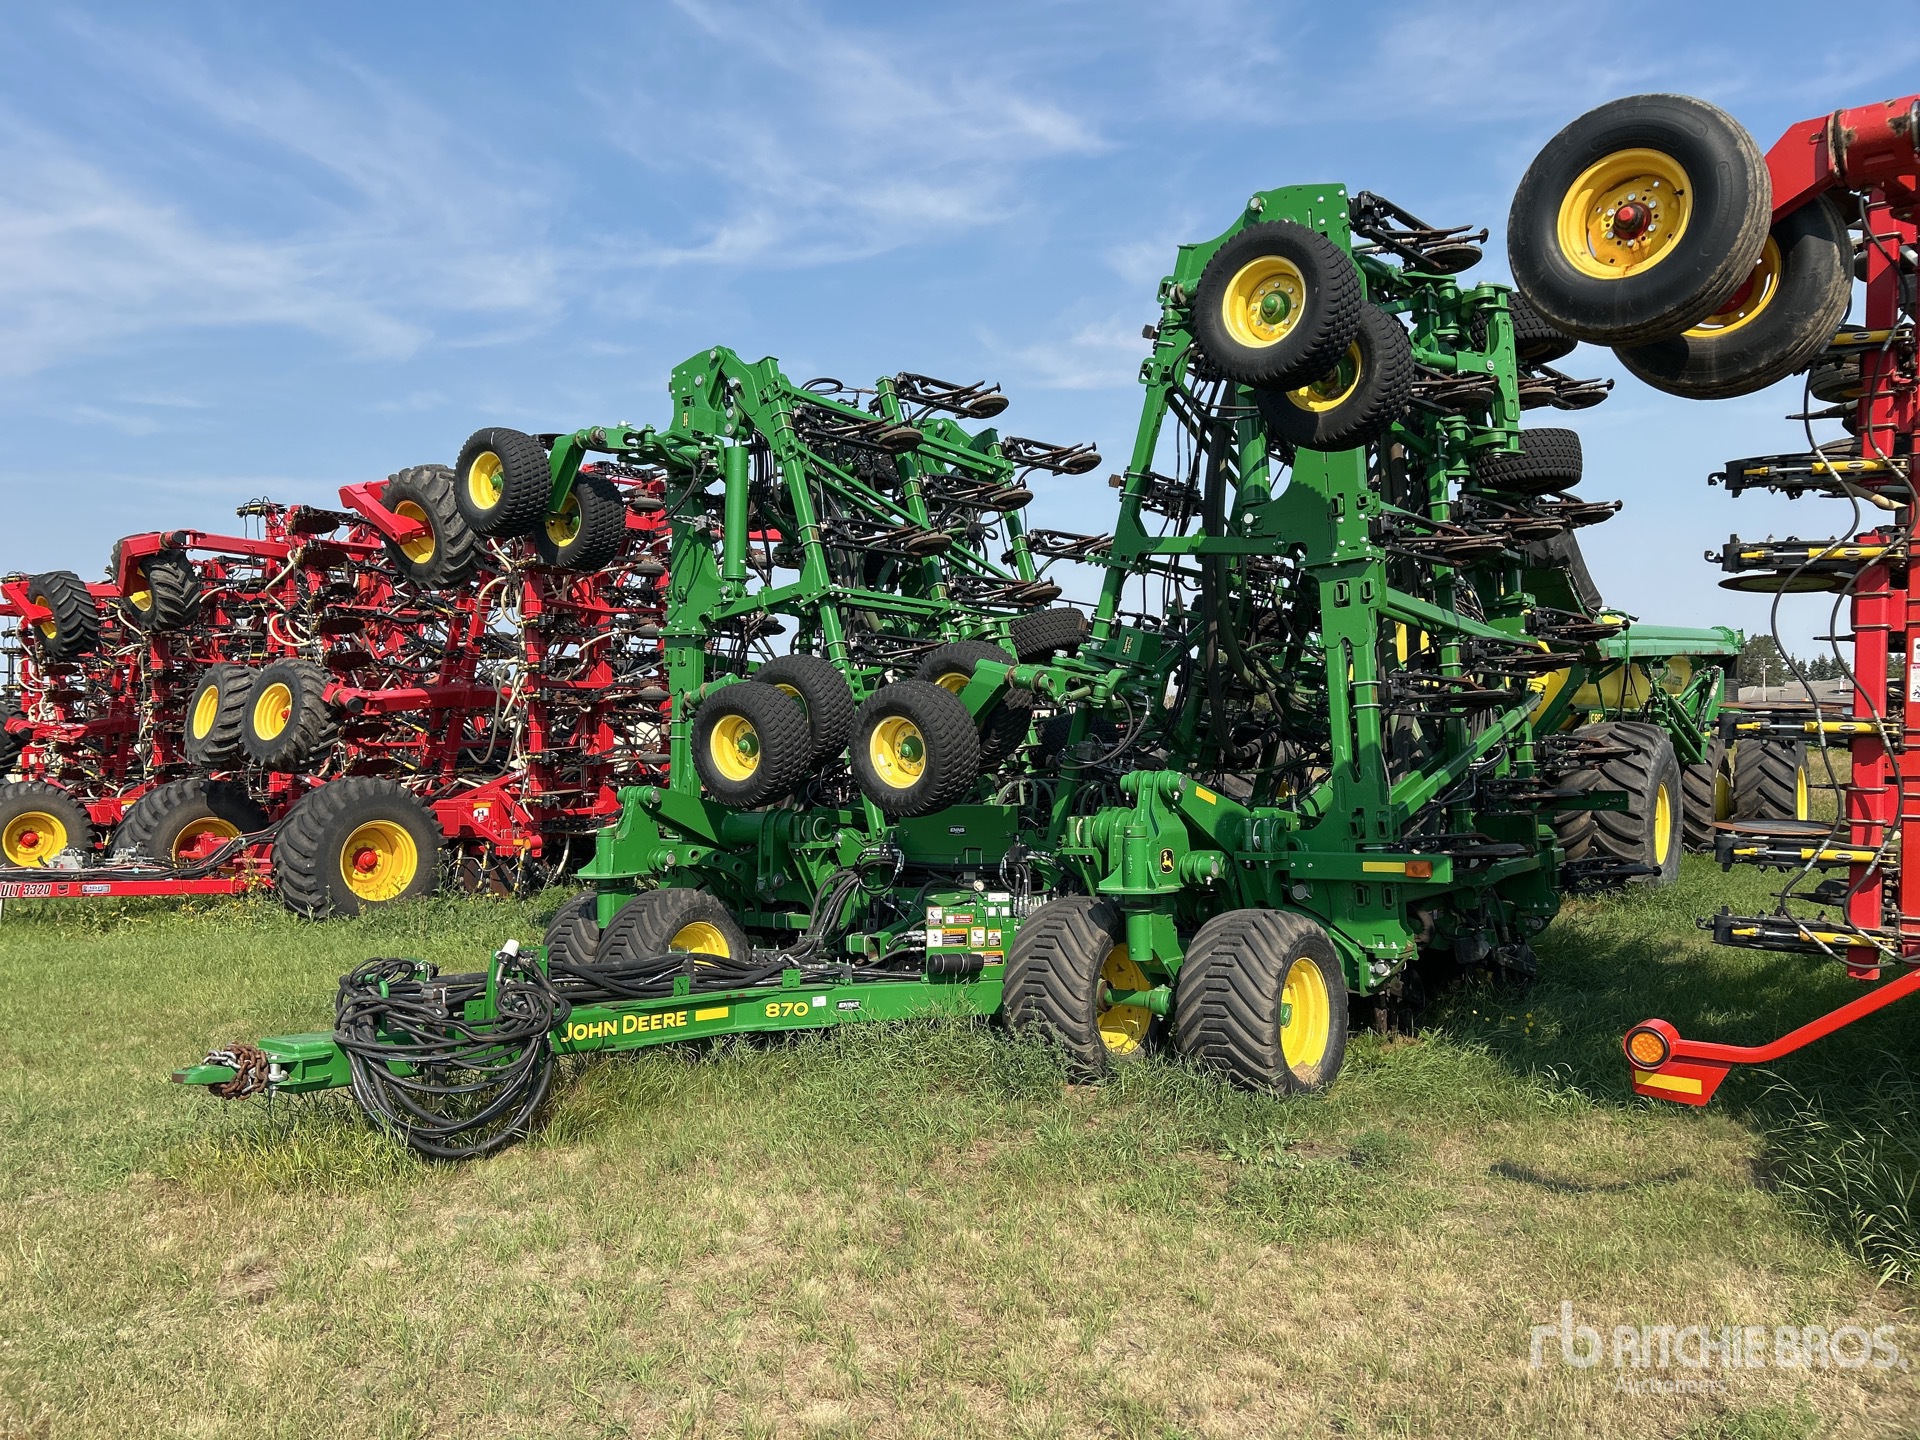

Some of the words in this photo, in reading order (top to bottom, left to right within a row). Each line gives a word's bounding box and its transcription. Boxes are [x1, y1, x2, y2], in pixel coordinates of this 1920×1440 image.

[23, 884, 51, 895] 3320
[765, 1001, 809, 1018] 870
[561, 1019, 618, 1043] JOHN
[622, 1010, 688, 1035] DEERE
